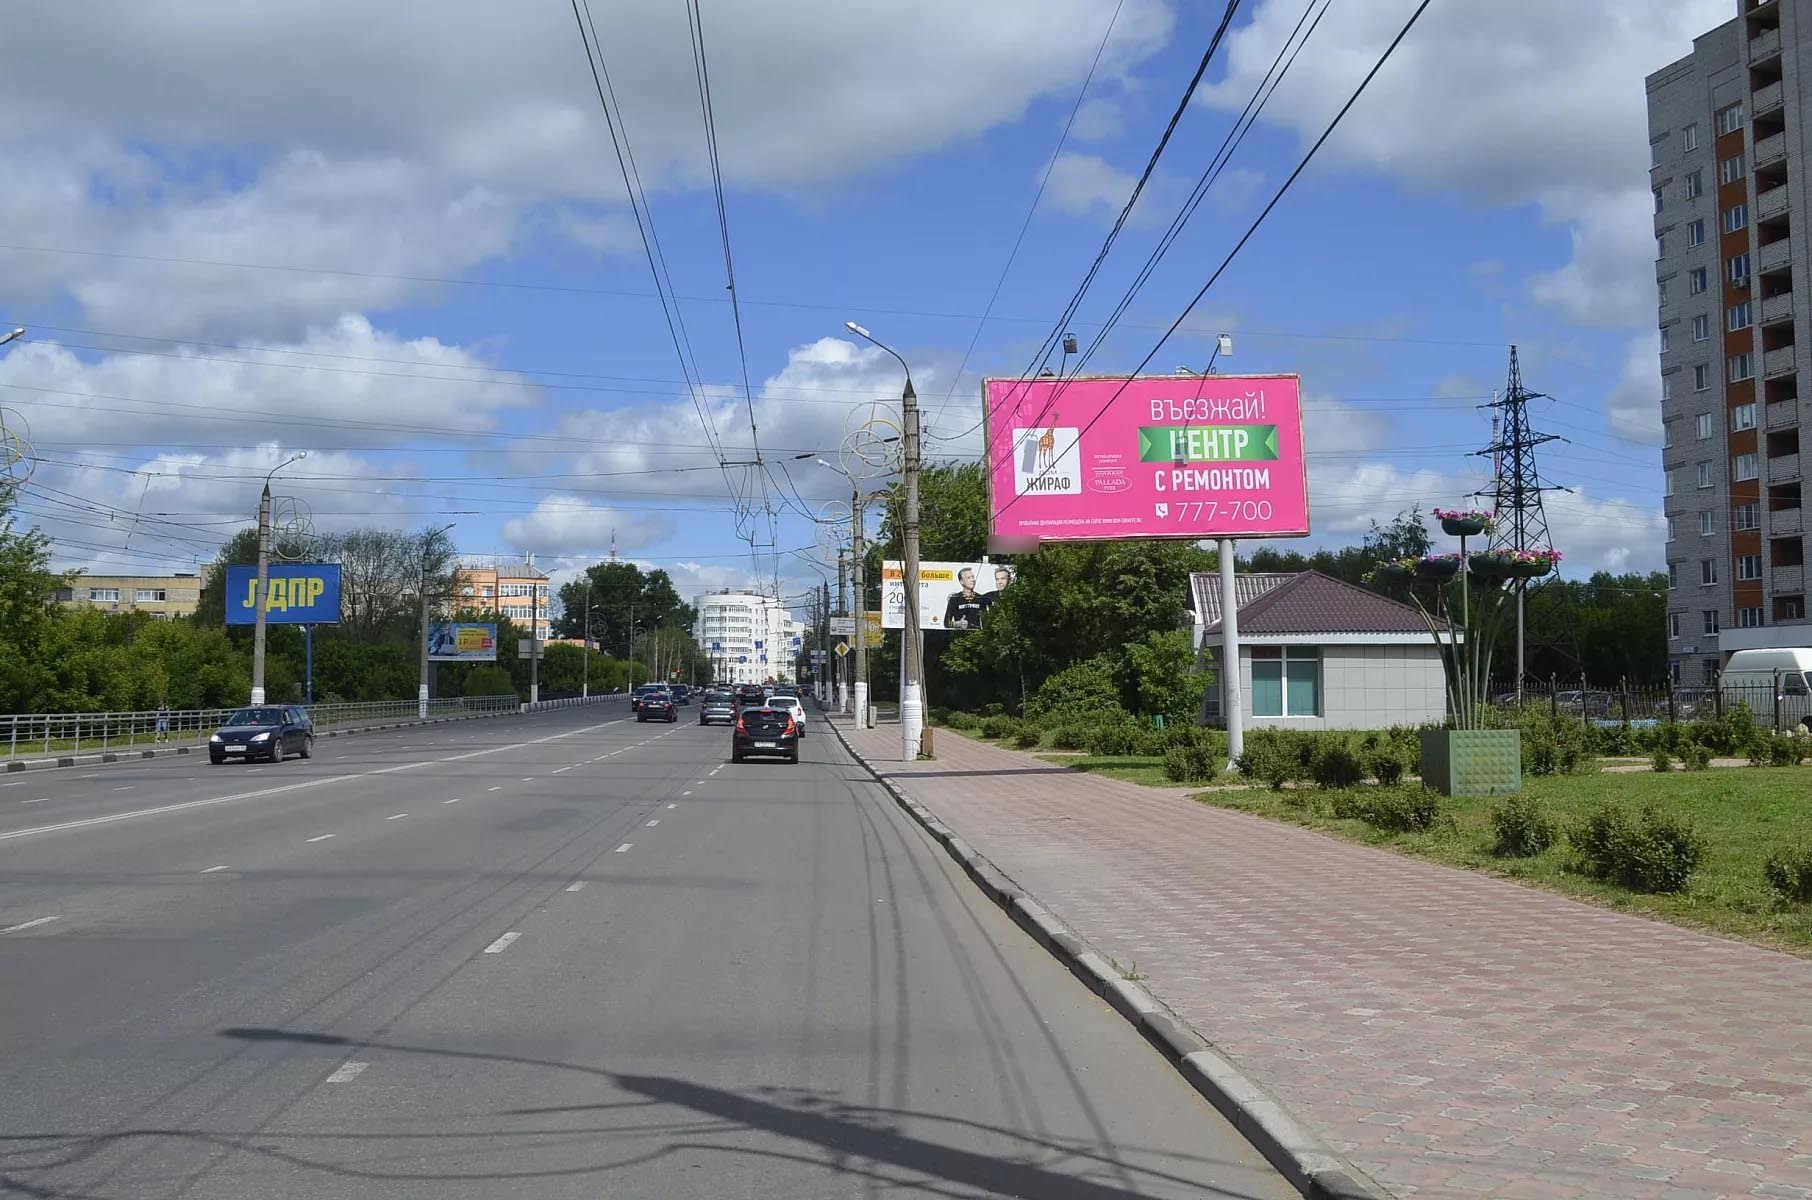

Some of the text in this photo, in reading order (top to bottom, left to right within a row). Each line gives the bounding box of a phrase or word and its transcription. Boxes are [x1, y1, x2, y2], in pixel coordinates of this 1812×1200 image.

[1169, 429, 1249, 464] ЦЕНТР
[1026, 476, 1071, 491] ЖИРАФ
[1155, 468, 1270, 491] С РЕМОНТОМ
[1175, 500, 1273, 522] 777-700
[921, 570, 950, 579] больше
